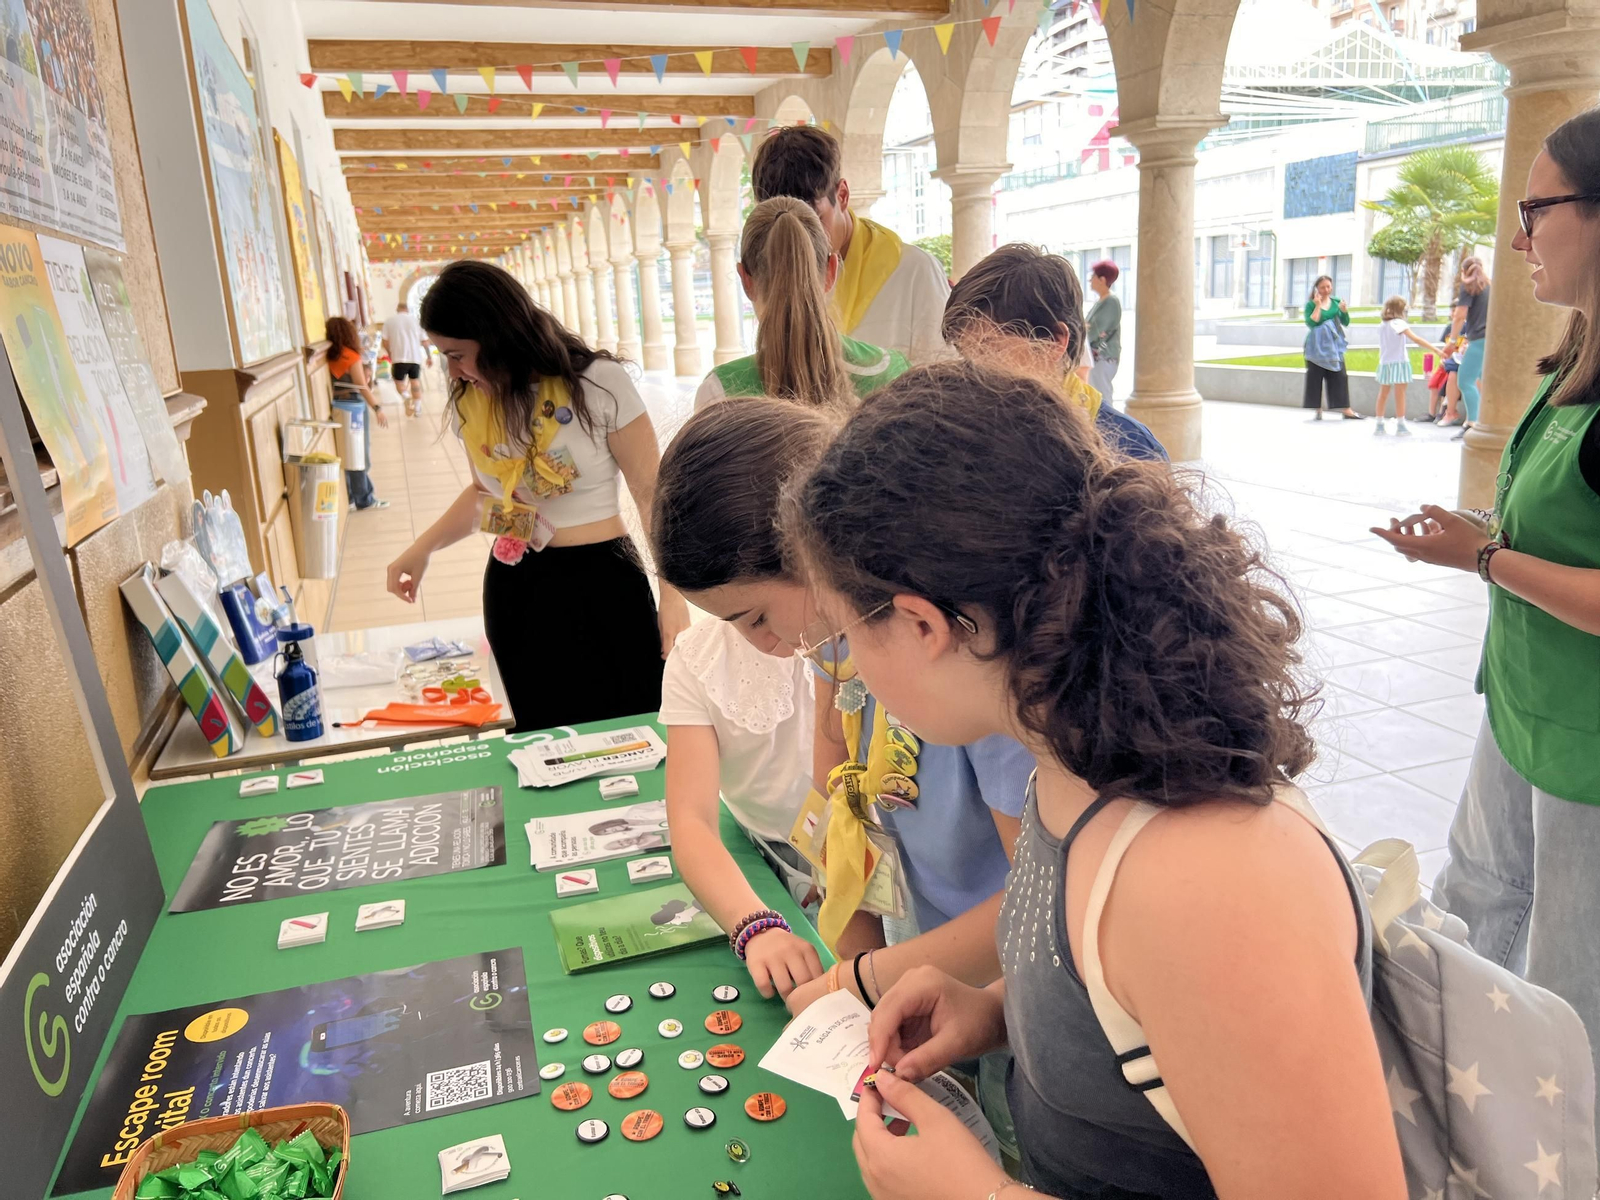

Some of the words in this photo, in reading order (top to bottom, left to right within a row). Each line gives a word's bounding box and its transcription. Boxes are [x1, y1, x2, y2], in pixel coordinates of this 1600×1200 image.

[377, 751, 492, 774] asociación
[393, 743, 490, 763] española
[282, 813, 315, 832] LO
[376, 807, 414, 853] LLAMA
[232, 853, 268, 874] ES
[297, 856, 336, 890] QUE
[335, 823, 376, 881] SIENTES
[371, 857, 406, 879] SE
[219, 876, 259, 902] NO
[56, 892, 97, 973] asociación
[65, 929, 101, 1003] española
[74, 975, 101, 1033] contra
[98, 964, 106, 982] o
[103, 919, 128, 971] cancro
[100, 1084, 160, 1168] Escape
[140, 1029, 179, 1081] room
[204, 1077, 219, 1107] concerto
[212, 1050, 227, 1078] intervido
[154, 1086, 196, 1132] xital
